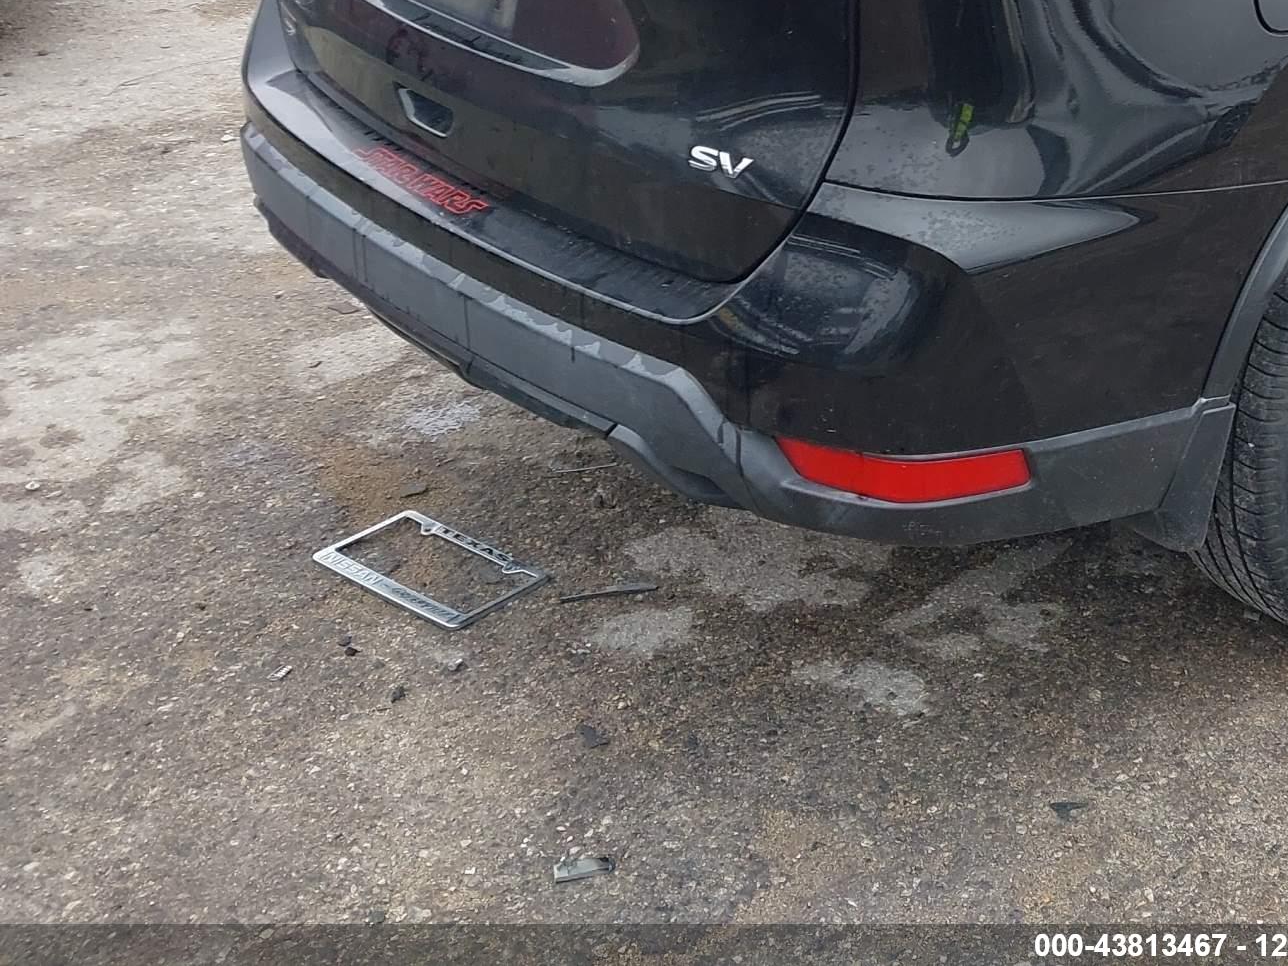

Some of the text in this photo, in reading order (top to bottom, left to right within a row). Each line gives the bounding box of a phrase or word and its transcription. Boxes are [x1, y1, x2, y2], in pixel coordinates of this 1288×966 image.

[687, 145, 754, 179] SV
[353, 146, 490, 215] STAR WARS
[439, 526, 511, 562] TEXAS
[322, 552, 383, 586] NISSAN
